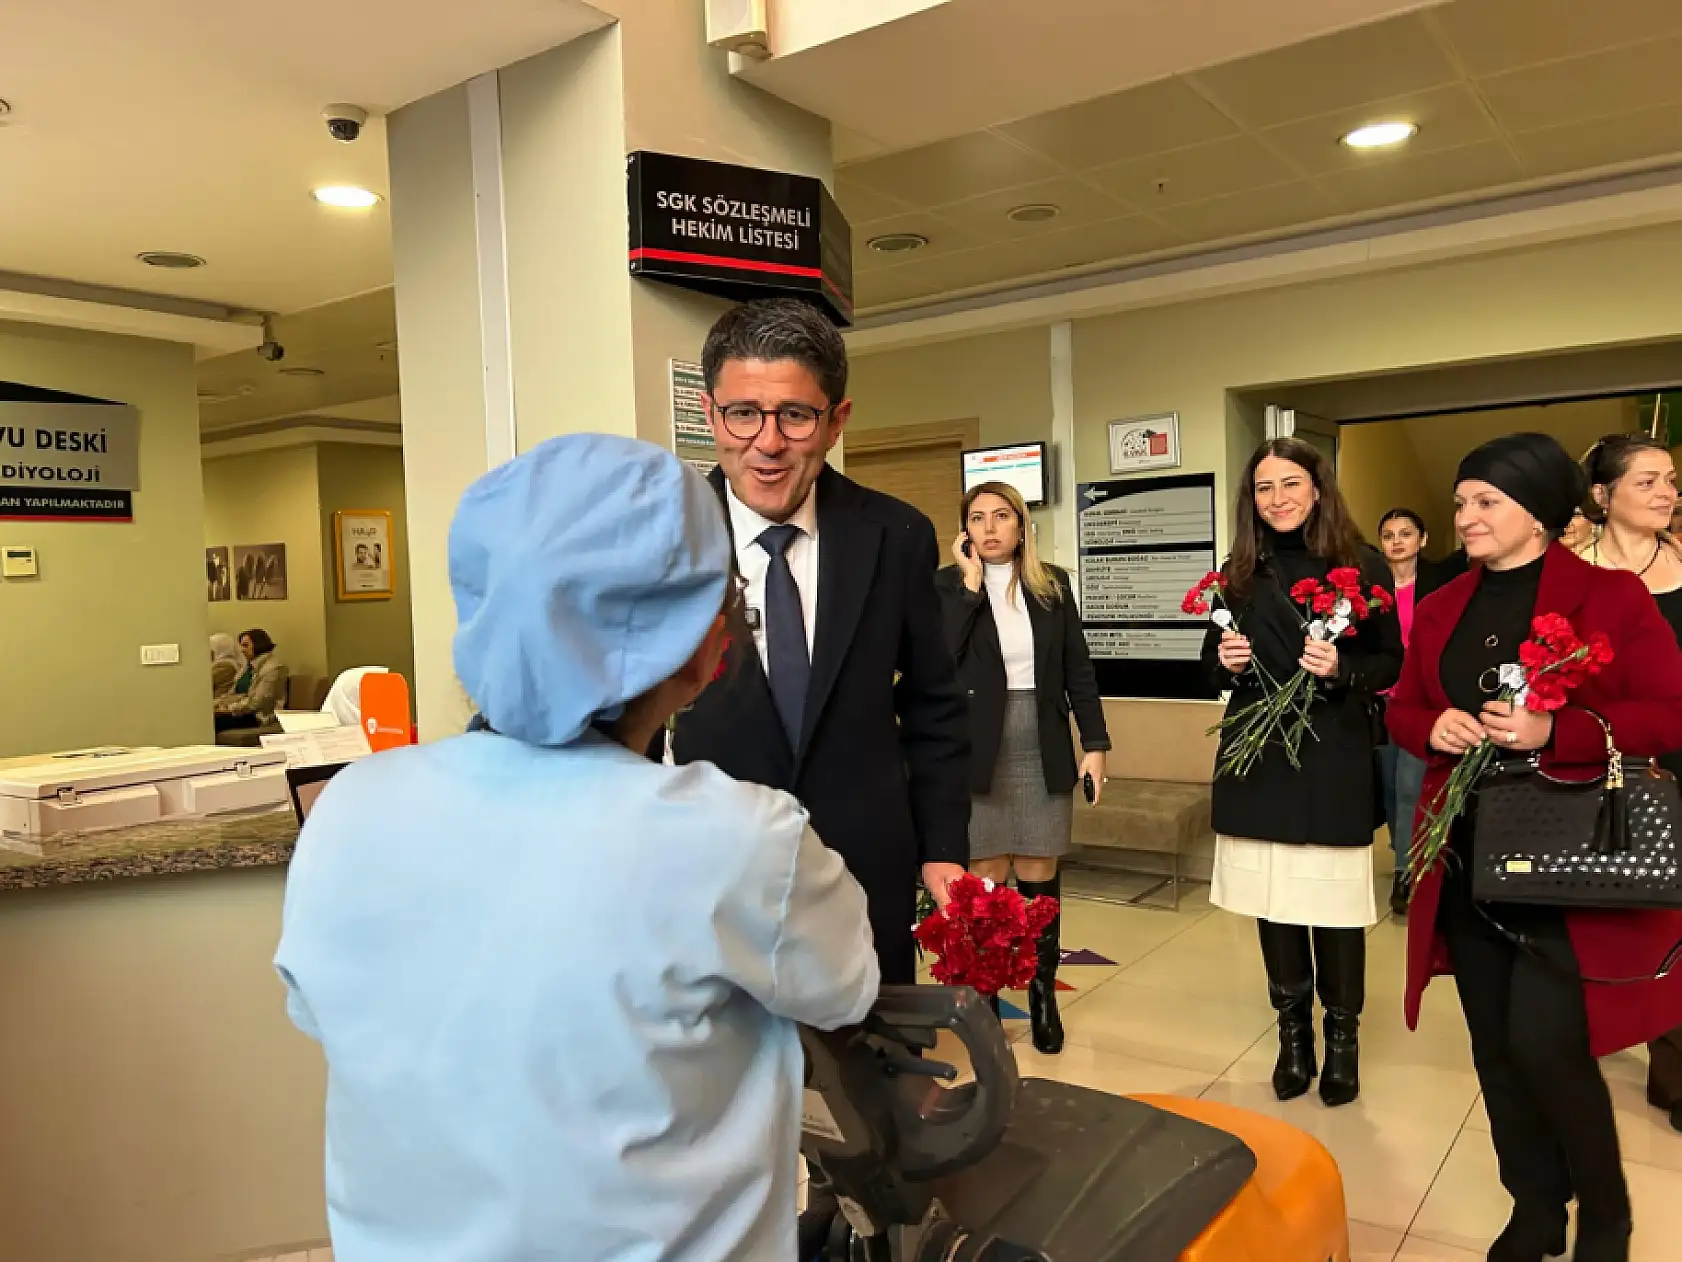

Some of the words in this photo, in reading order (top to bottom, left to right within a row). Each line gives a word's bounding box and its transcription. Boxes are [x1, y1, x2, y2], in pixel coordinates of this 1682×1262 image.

[656, 190, 697, 212] SGK
[702, 194, 811, 228] SÖZLEŞMELİ
[671, 218, 734, 242] HEKİM
[739, 223, 799, 250] LİSTESİ
[36, 428, 107, 453] DESKİ
[24, 498, 124, 509] YAPILMAKTADIR
